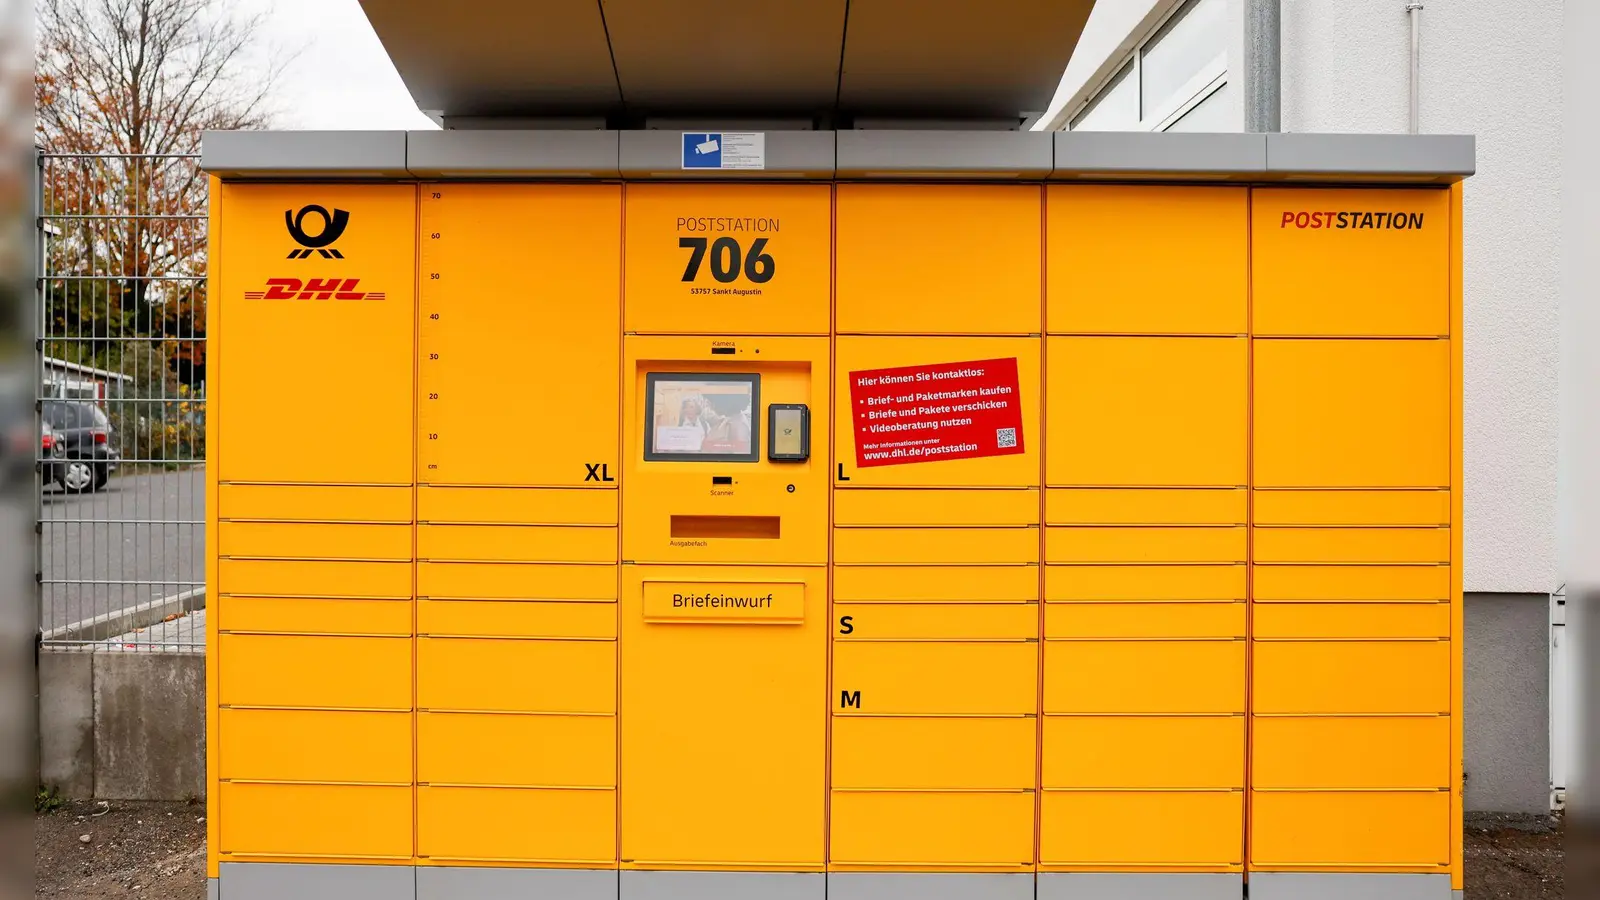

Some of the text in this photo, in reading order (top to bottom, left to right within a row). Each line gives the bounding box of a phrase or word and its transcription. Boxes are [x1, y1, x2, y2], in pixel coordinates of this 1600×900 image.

[677, 217, 780, 232] POSTSTATION
[1280, 211, 1424, 229] POSTSTATION
[679, 237, 775, 283] 706
[430, 272, 440, 280] 50
[263, 278, 366, 300] DHL
[732, 288, 762, 297] Augustin
[858, 368, 985, 387] Hier können Sie kontaktlos:
[867, 385, 1012, 406] Brief- und Paketmarken kaufen
[868, 400, 1008, 420] Briefe und Pakete verschicken
[869, 417, 972, 434] Videoberatung nutzen
[864, 443, 978, 460] www.dhl.de/poststation
[879, 439, 923, 448] Informationen
[923, 437, 940, 445] unter
[584, 463, 614, 482] XL
[837, 463, 850, 482] L
[672, 593, 773, 608] Briefeinwurf
[839, 616, 854, 635] S
[840, 691, 861, 709] M
